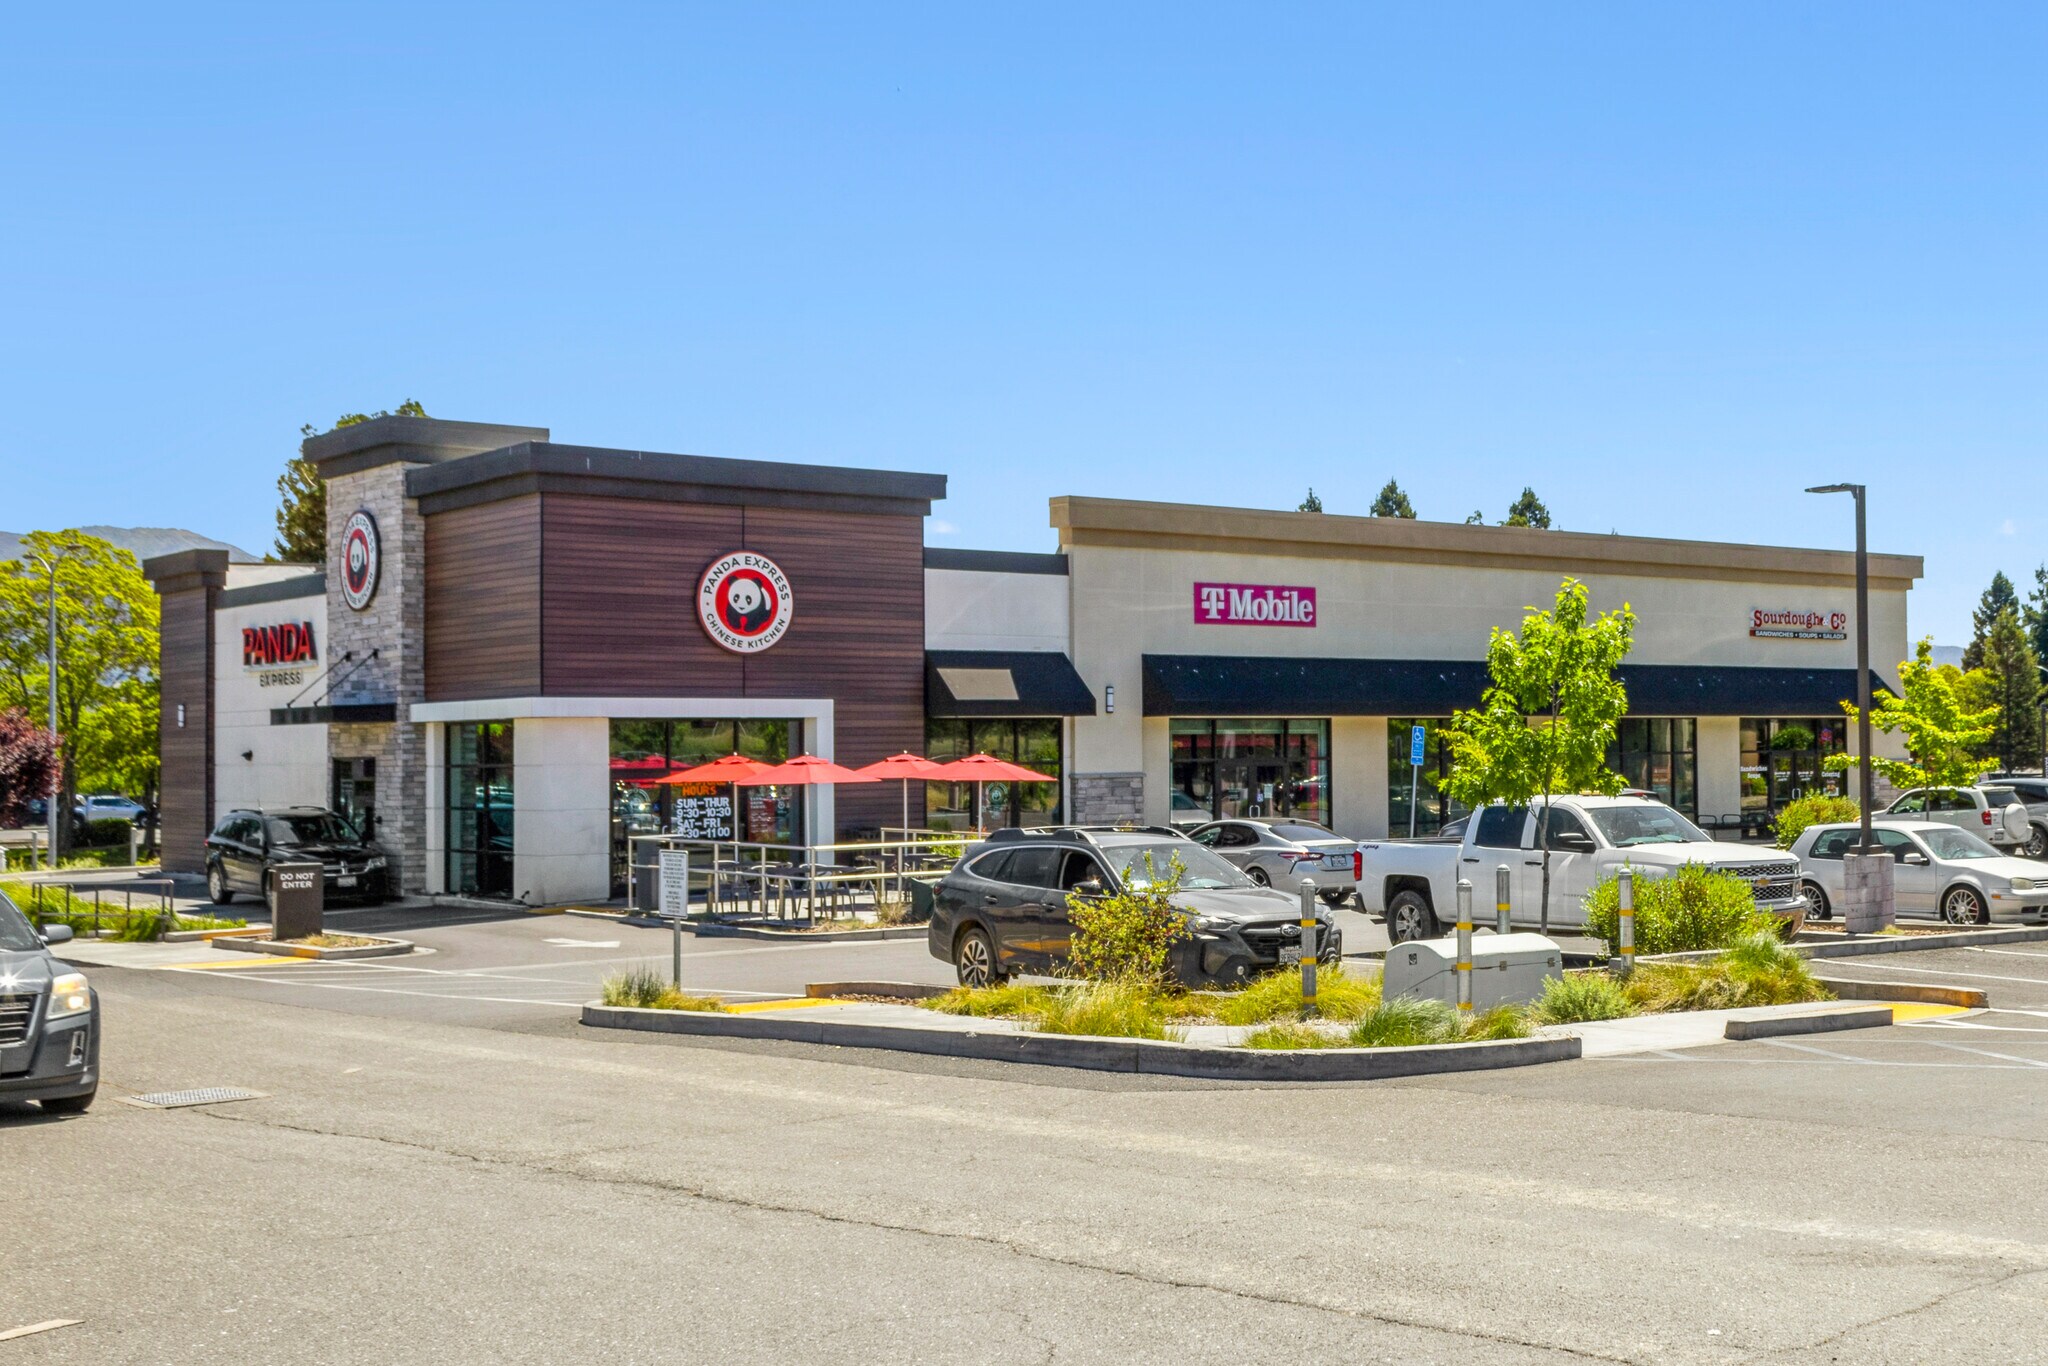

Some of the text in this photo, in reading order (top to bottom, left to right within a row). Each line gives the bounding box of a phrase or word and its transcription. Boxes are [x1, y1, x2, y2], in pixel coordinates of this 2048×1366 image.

[703, 555, 789, 601] PANDA EXPRESS
[1227, 588, 1314, 622] Mobile
[1754, 609, 1821, 629] Sourdough
[706, 613, 786, 649] CHINESE KITCHEN
[1755, 630, 1794, 638] SANDWICHES
[242, 621, 317, 666] PANDA
[260, 671, 303, 687] EXPRESS
[682, 786, 717, 796] HOURS
[280, 872, 315, 881] DO NOT
[282, 881, 313, 889] ENTER
